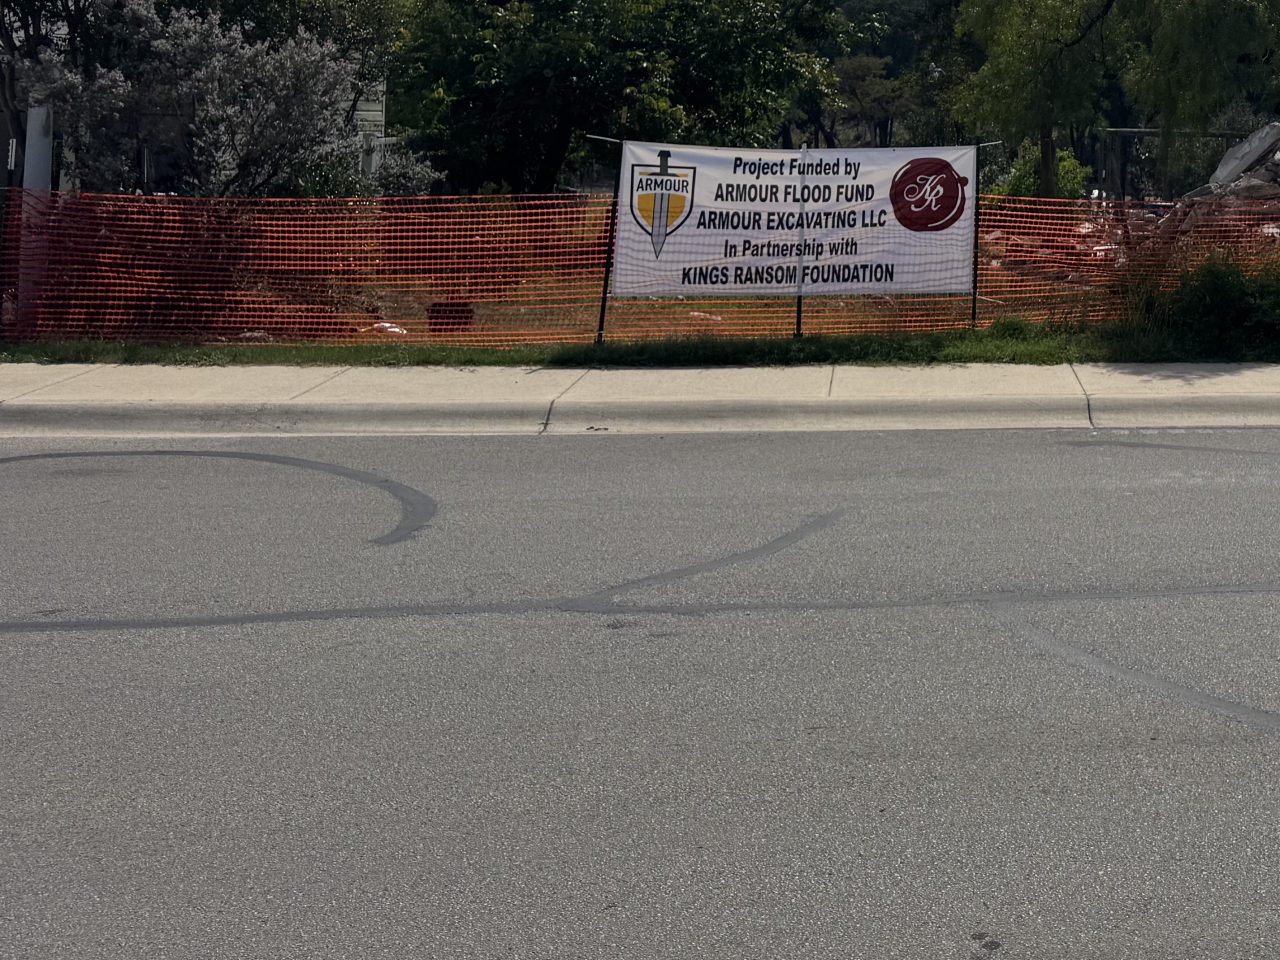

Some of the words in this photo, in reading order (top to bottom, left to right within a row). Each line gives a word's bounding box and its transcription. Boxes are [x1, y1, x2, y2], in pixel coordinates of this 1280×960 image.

[733, 157, 785, 180] Project
[789, 158, 840, 176] Funded
[844, 157, 861, 180] by
[636, 177, 689, 194] ARMOUR
[714, 183, 779, 202] ARMOUR
[783, 184, 832, 202] FLOOD
[836, 184, 875, 201] FUND
[697, 210, 762, 230] ARMOUR
[766, 210, 857, 230] EXCAVATING
[861, 209, 887, 228] LLC
[724, 239, 737, 258] In
[742, 239, 824, 261] Partnership
[829, 237, 858, 256] with
[681, 266, 730, 285] KINGS
[733, 265, 797, 284] RANSOM
[801, 263, 895, 283] FOUNDATION
